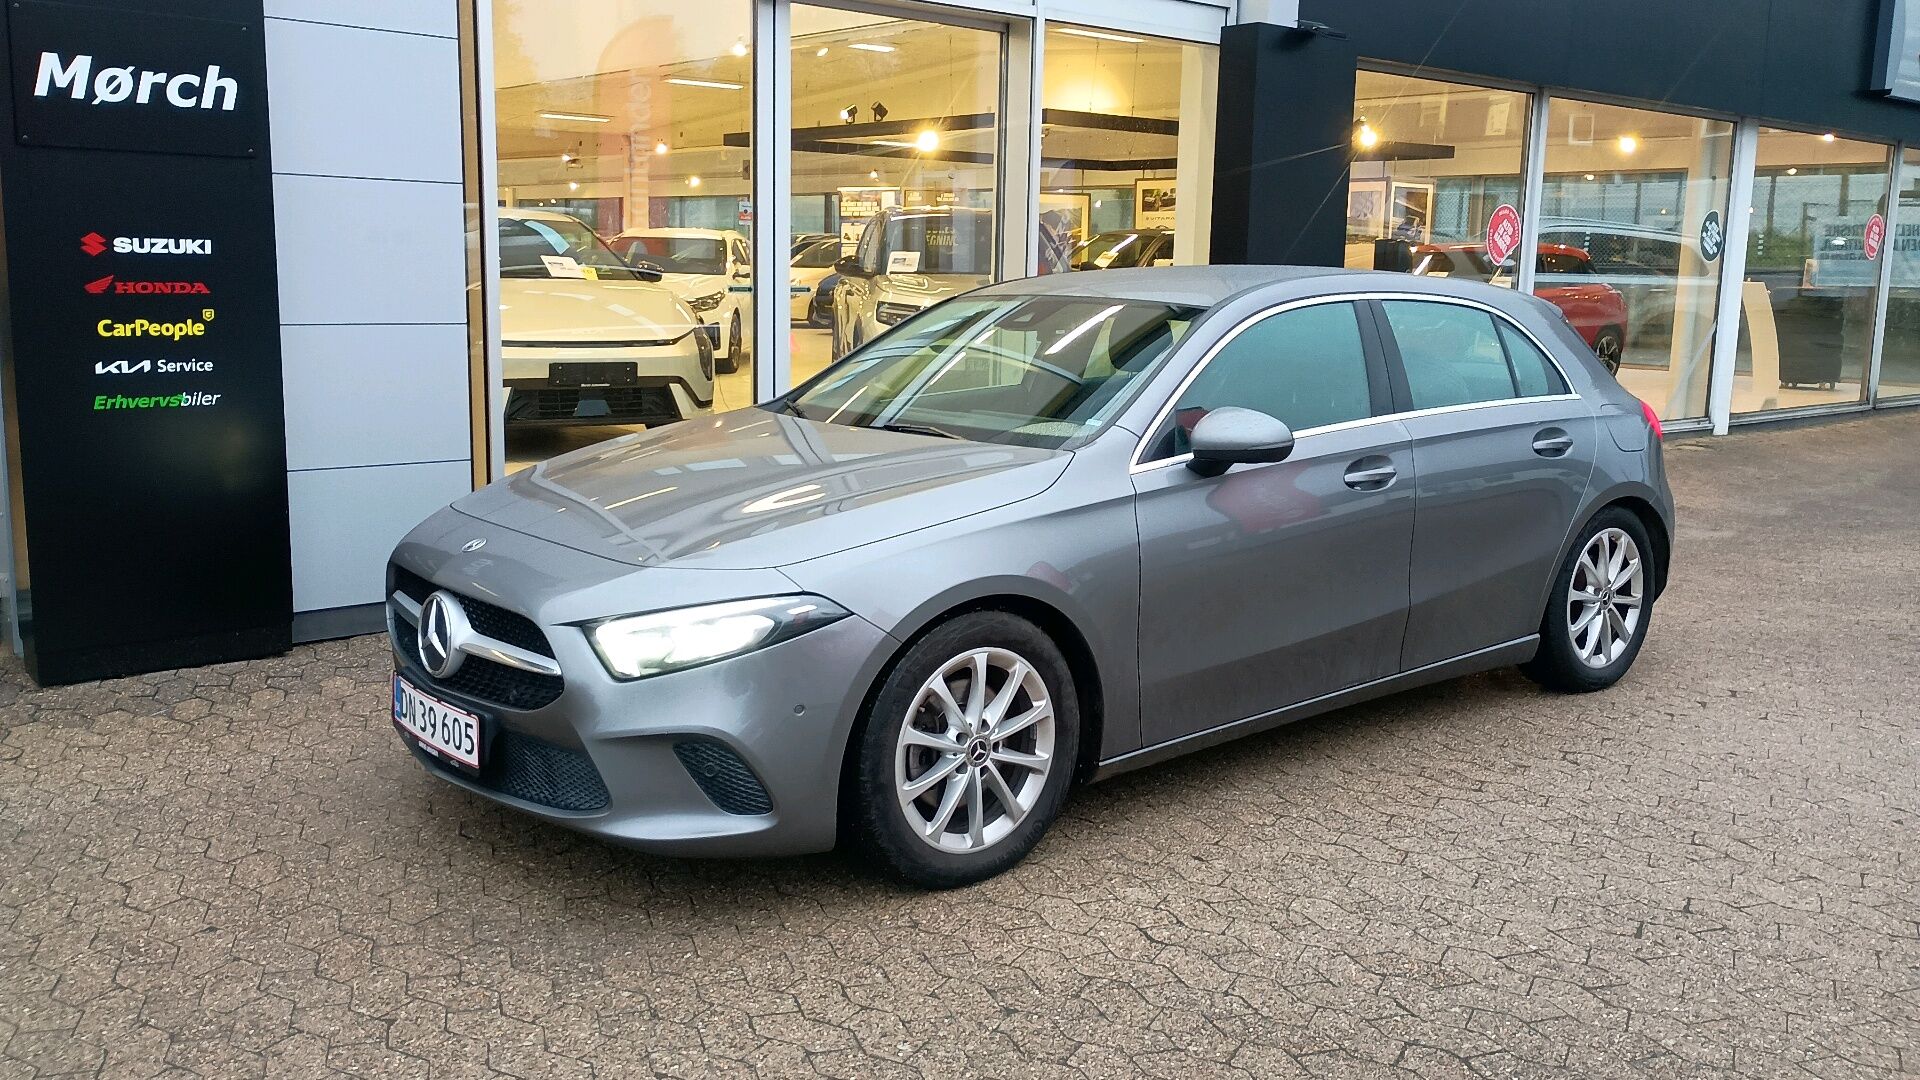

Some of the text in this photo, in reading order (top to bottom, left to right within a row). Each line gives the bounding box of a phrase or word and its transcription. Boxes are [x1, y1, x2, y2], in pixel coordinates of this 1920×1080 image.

[33, 51, 239, 111] Mørch
[113, 237, 212, 254] SUZUKI
[114, 281, 211, 294] HONDA
[97, 318, 205, 341] CarPeople
[95, 358, 214, 375] KIA Service
[93, 391, 222, 410] Erhvervsbiler
[401, 687, 416, 727] DN
[419, 699, 437, 739] 39
[441, 712, 475, 755] 605
